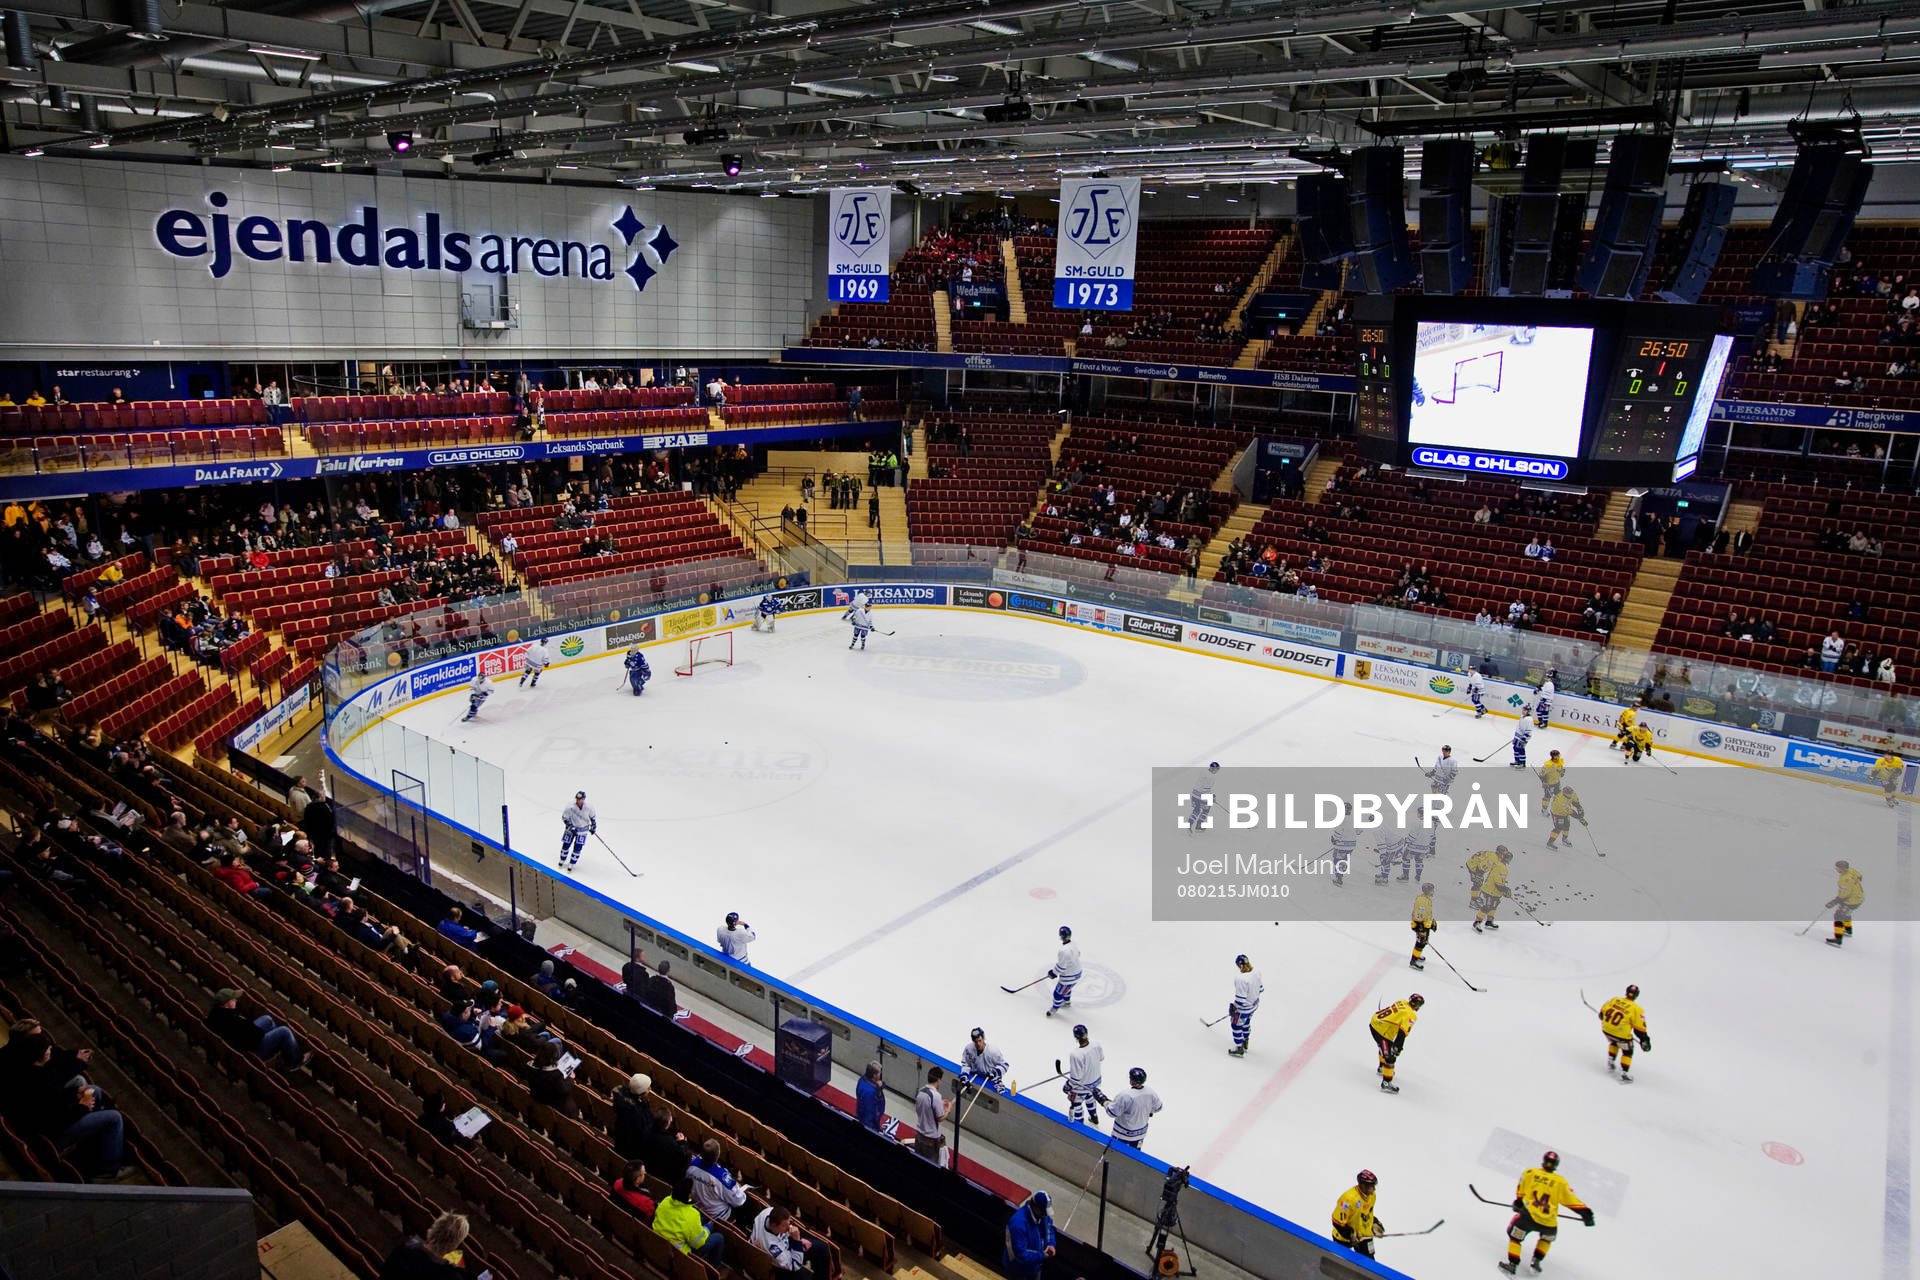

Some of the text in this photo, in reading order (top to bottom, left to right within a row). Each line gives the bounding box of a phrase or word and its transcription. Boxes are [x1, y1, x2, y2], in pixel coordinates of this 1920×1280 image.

[836, 264, 882, 275] SM-GULD
[1065, 265, 1125, 278] SM-GULD
[839, 278, 879, 300] 1969
[956, 285, 978, 297] Weda
[1068, 282, 1119, 307] 1973
[1362, 329, 1384, 343] 26:50
[1639, 341, 1689, 358] 26:50
[965, 356, 992, 365] office
[1080, 363, 1096, 371] ERNST
[1102, 364, 1122, 373] YOUNG
[57, 369, 132, 379] star restaurang
[1135, 367, 1168, 376] Swedbank
[1198, 370, 1227, 381] Bilmetro
[1658, 361, 1666, 376] 1
[1272, 380, 1320, 390] Handelsbanken
[1274, 373, 1319, 383] HSB Dalarna
[1630, 379, 1687, 396] 0 0
[1728, 405, 1796, 417] LEKSANDS
[1856, 410, 1905, 422] Bergkvist
[1854, 419, 1886, 430] Insjön
[545, 438, 625, 454] Leksands Sparbank
[654, 434, 700, 448] PEAB
[433, 447, 519, 462] CLAS OHLSON
[315, 456, 404, 474] Falu Kuriren
[1419, 450, 1560, 477] CLAS OHLSON
[714, 582, 776, 600] Leksands Sparbank
[959, 590, 984, 598] Leksands
[627, 597, 697, 618] Leksands Sparbank
[959, 596, 984, 605] Sparbank
[527, 614, 607, 638] Leksands Sparbank
[1128, 617, 1153, 630] Color
[1153, 621, 1179, 635] Print
[411, 632, 503, 661] Leksands Sparbank
[1198, 632, 1256, 652] ODDSET
[340, 657, 382, 674] parbank
[485, 658, 501, 668] BRA
[1273, 648, 1335, 668] ODDSET
[413, 663, 474, 691] Björnkläder
[485, 666, 503, 677] HUS
[1375, 663, 1419, 679] LEKSANDS
[1373, 672, 1417, 688] KOMMUN
[1723, 743, 1771, 758] PAPER AB
[1724, 736, 1776, 753] GRYCKSBO
